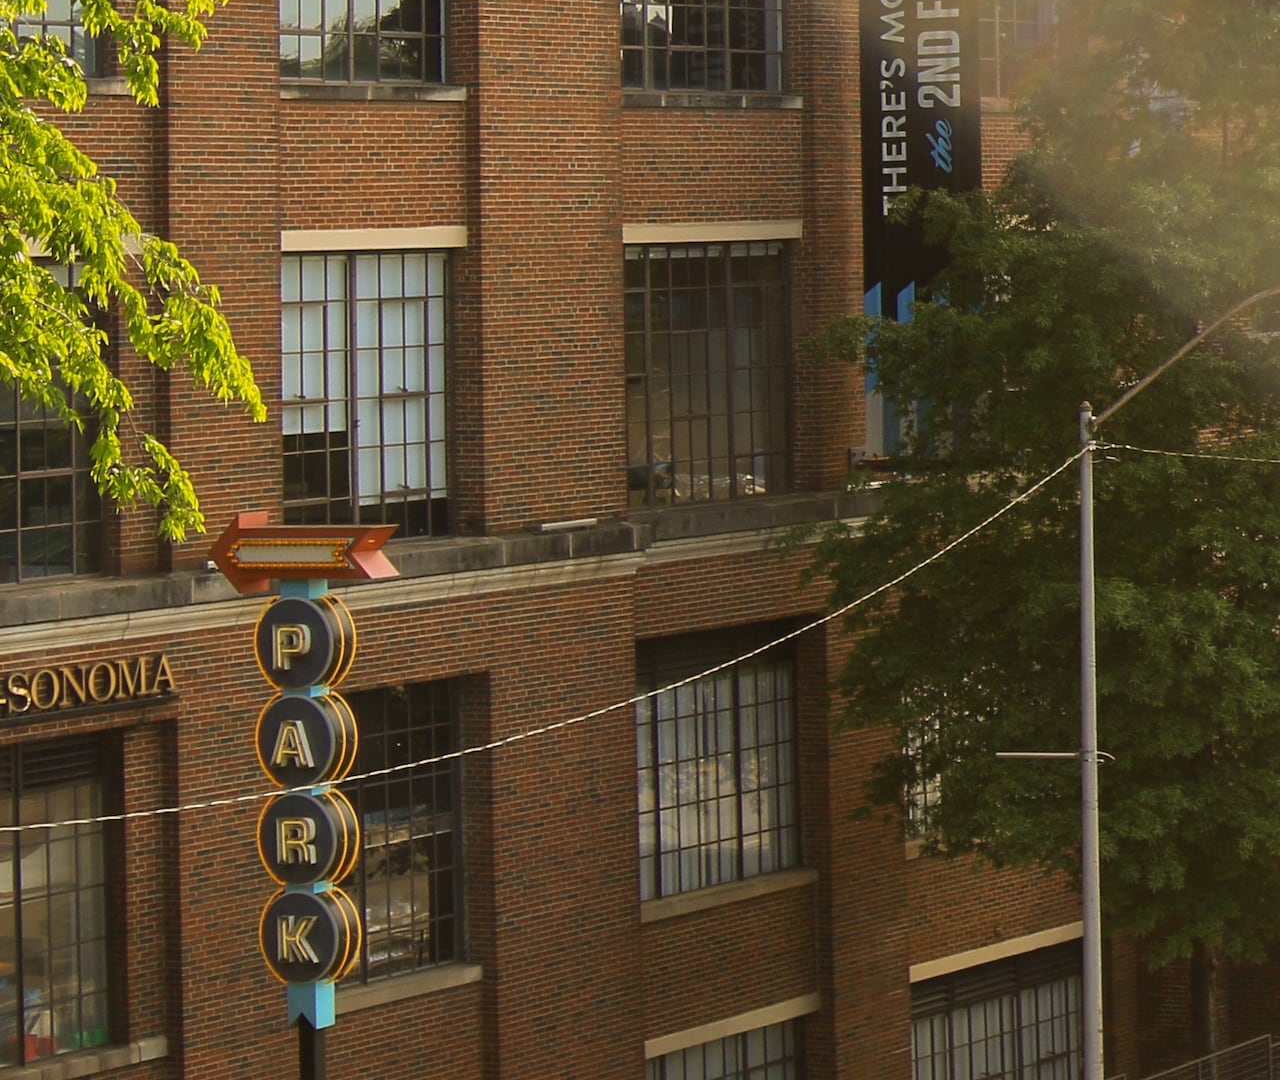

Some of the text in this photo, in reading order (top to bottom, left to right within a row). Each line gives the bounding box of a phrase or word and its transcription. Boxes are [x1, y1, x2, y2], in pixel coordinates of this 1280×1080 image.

[916, 28, 961, 109] 2ND
[925, 117, 953, 173] the
[271, 622, 320, 964] PARK
